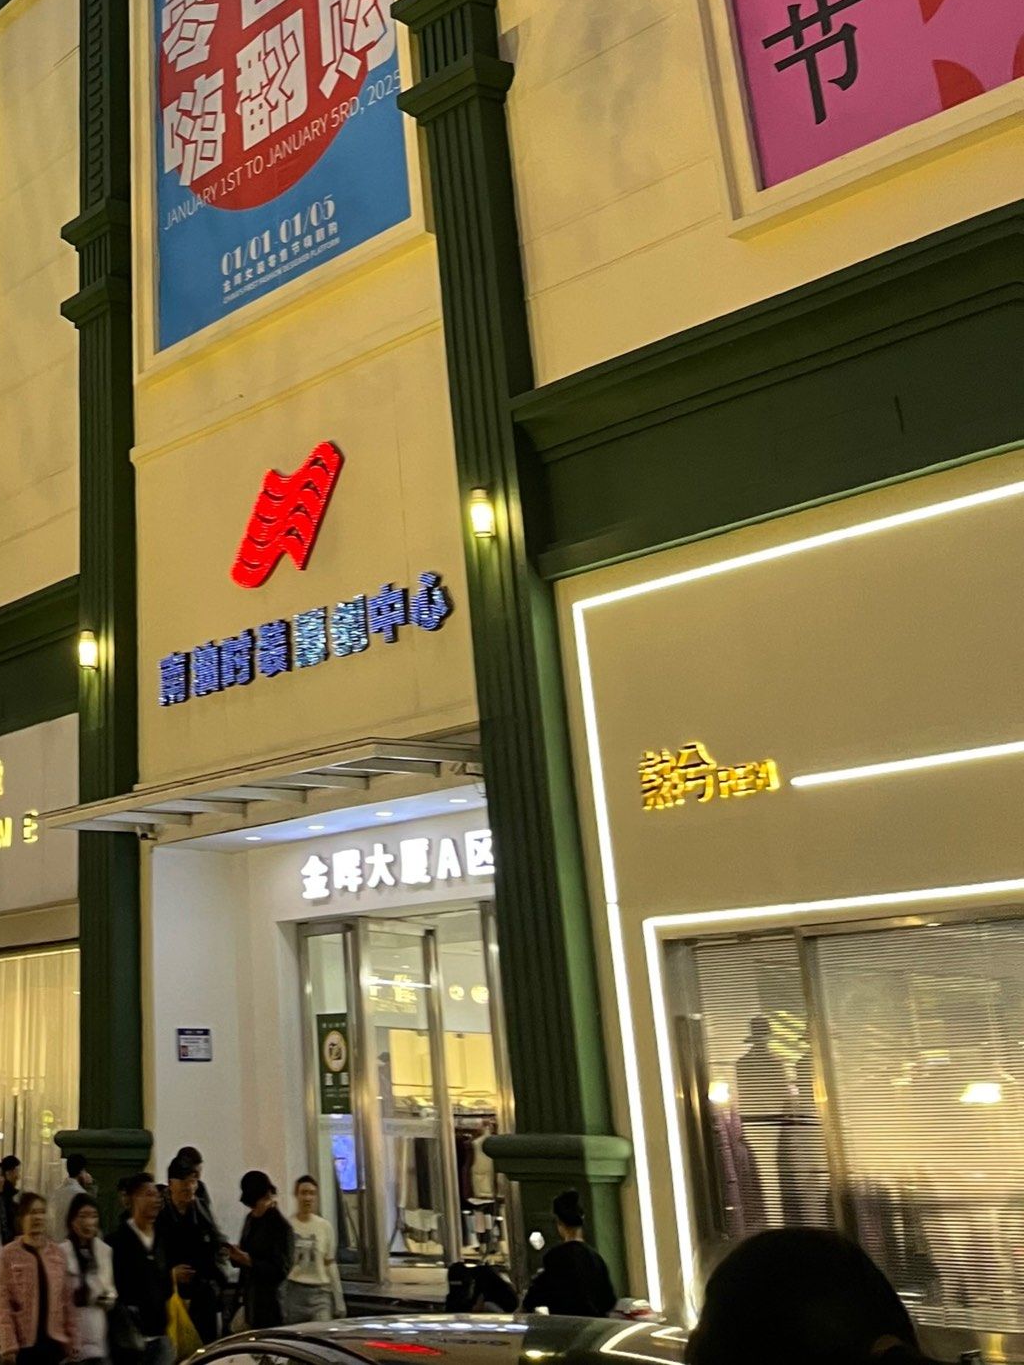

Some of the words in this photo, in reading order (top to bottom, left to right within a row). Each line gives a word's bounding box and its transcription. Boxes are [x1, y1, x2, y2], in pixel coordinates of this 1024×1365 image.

[164, 182, 218, 230] JANUARY
[219, 169, 243, 197] 1ST
[244, 155, 264, 180] TO
[266, 119, 329, 167] JANUARY
